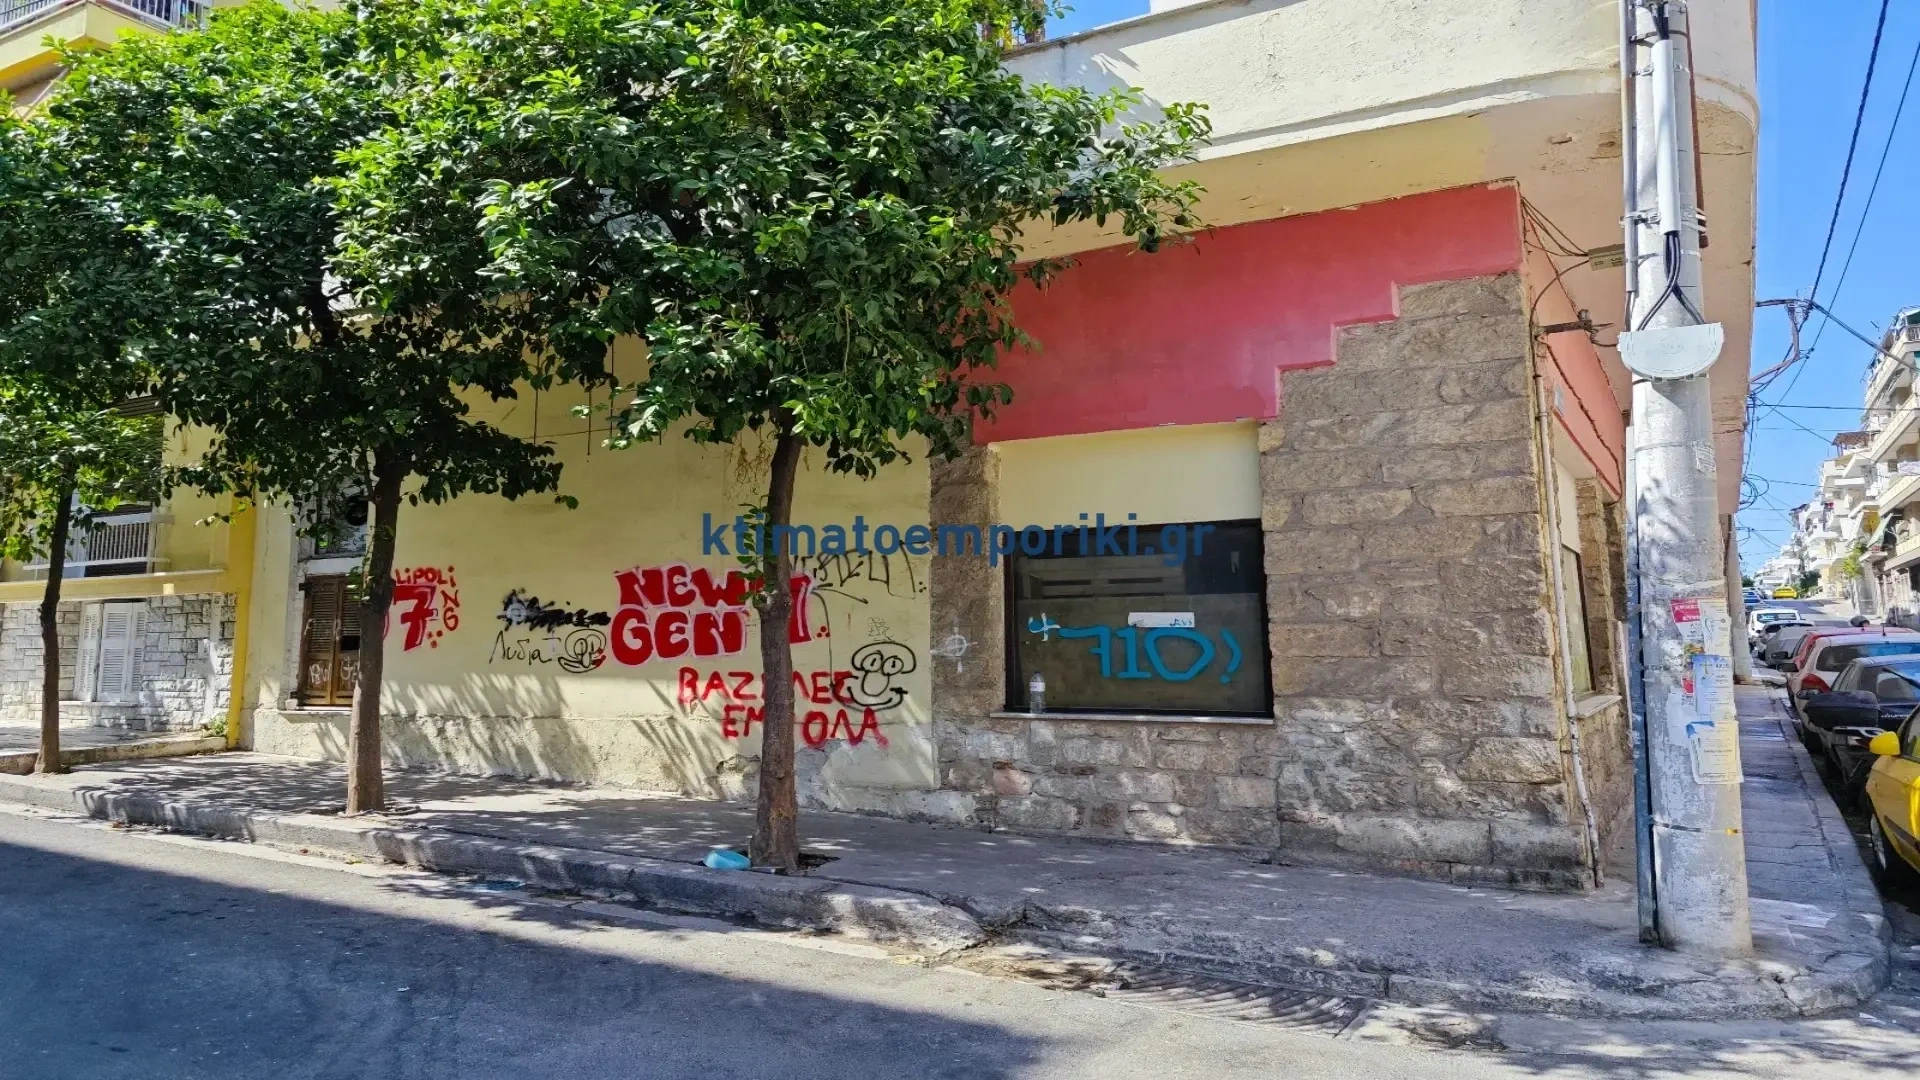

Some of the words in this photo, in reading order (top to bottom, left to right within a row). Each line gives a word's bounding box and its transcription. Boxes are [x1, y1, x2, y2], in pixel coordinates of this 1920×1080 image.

[614, 565, 746, 607] NEW
[610, 608, 744, 666] GEN
[678, 667, 855, 705] ΒΑΖΛΕΣ
[722, 704, 889, 748] ΕΜΟΛΑ
